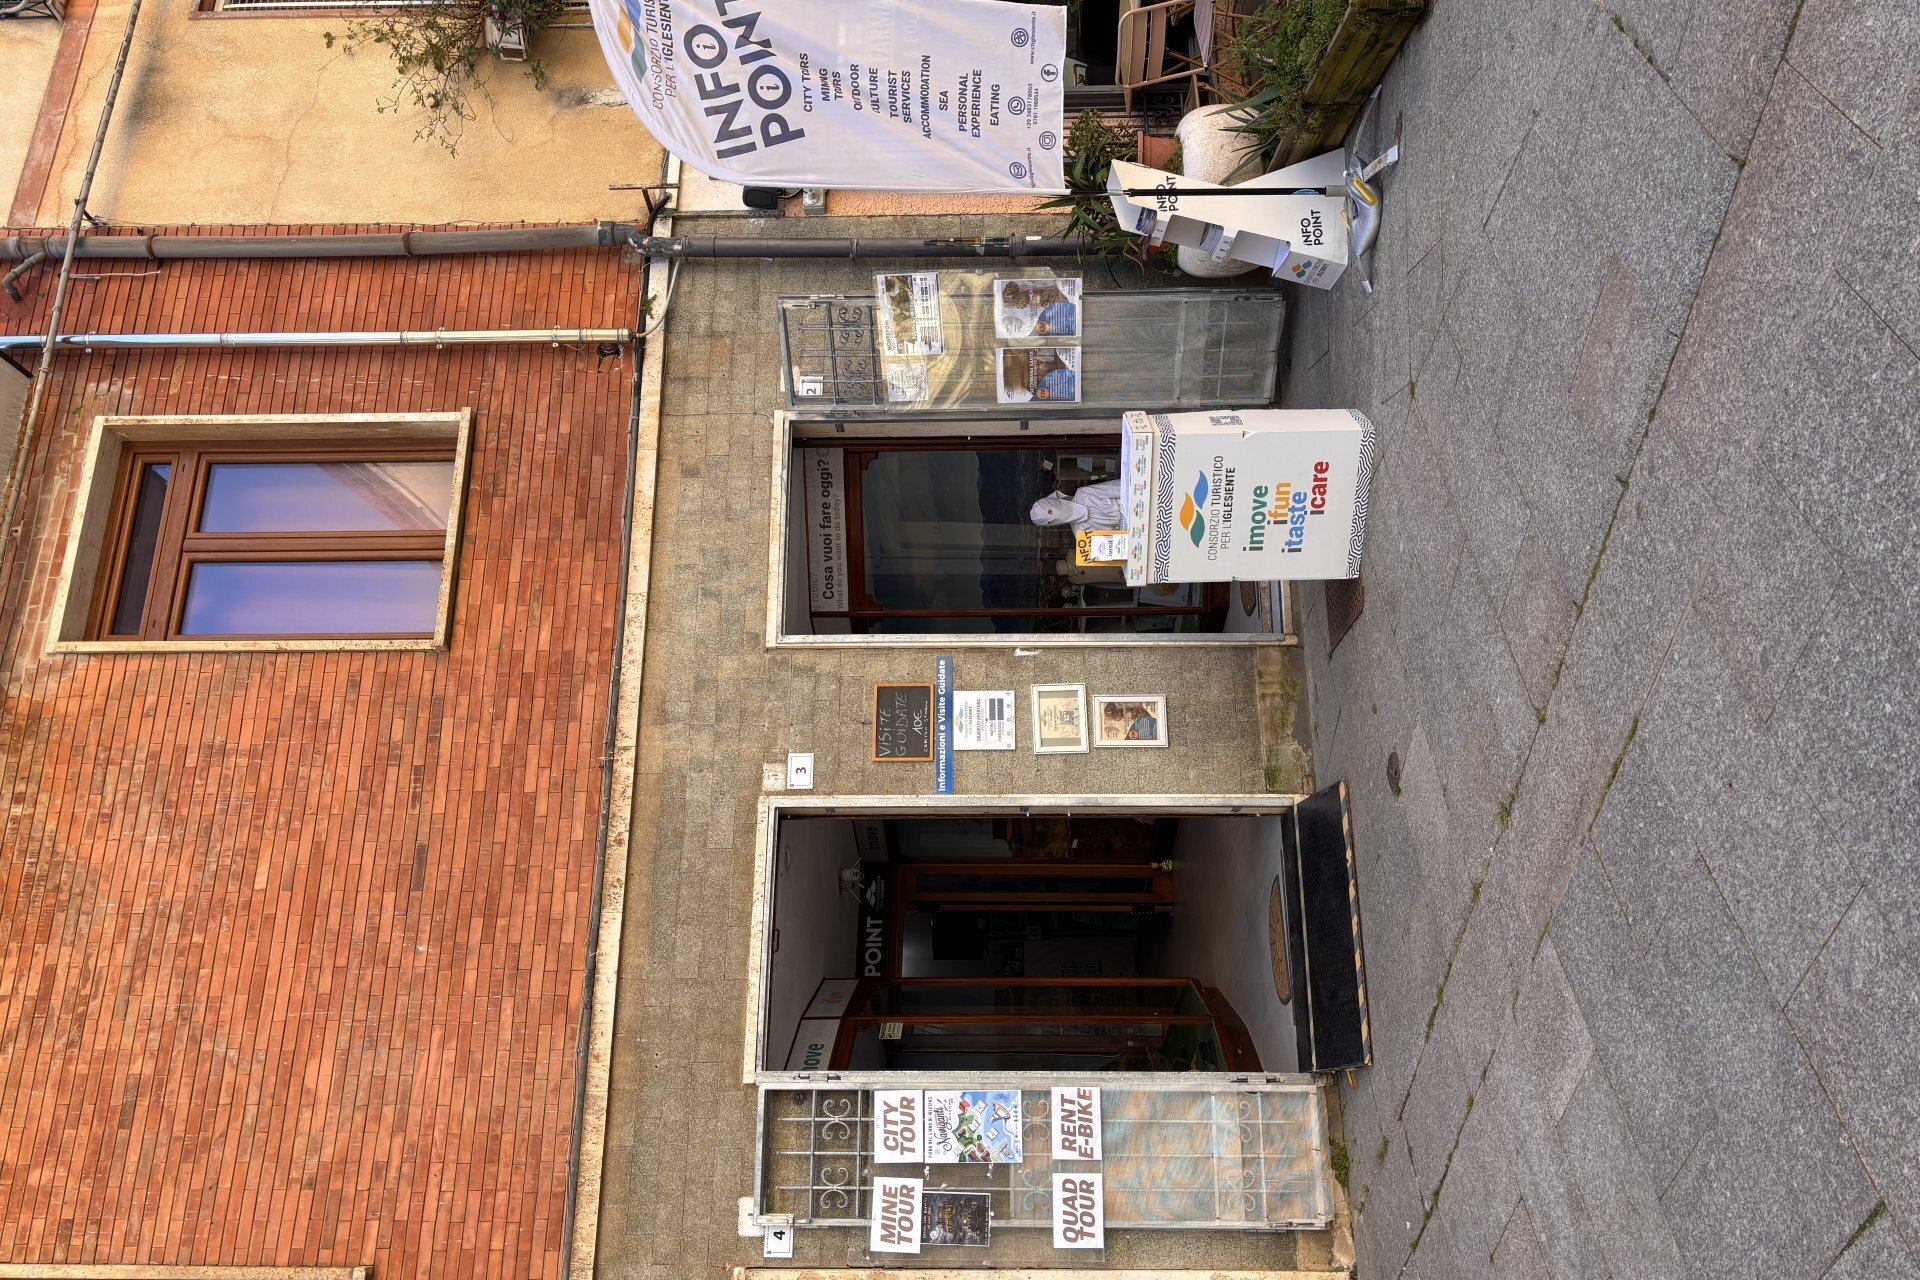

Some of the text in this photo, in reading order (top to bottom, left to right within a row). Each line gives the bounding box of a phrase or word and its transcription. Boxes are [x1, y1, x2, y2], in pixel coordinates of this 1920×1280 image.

[649, 38, 664, 109] CONSORZIO
[665, 74, 676, 98] PER
[684, 24, 758, 159] INFO
[888, 70, 899, 118] TOURIST
[901, 70, 912, 123] SERVICES
[920, 55, 932, 139] ACCOMMODATION
[803, 86, 812, 112] CITY
[939, 90, 948, 111] SEA
[958, 73, 968, 132] PERSONAL
[971, 69, 982, 138] EXPERIENCE
[990, 84, 1000, 126] EATING
[1166, 176, 1178, 211] PONT
[1301, 218, 1313, 246] INFO
[1311, 210, 1324, 245] POINT
[817, 459, 833, 497] oggi?
[1304, 462, 1329, 515] icare
[820, 502, 831, 529] fare
[833, 494, 842, 520] today?
[834, 522, 840, 530] do
[1208, 455, 1223, 560] CONSORZIO TURISTICO
[1221, 468, 1235, 549] PER L'IGLESIENTE
[1243, 486, 1268, 551] imove
[1267, 482, 1291, 525] ifun
[1282, 492, 1307, 553] itaste
[820, 534, 833, 562] vuoi
[835, 532, 841, 540] to
[1078, 540, 1092, 563] INFO
[822, 566, 834, 599] Cosa
[836, 579, 843, 587] do
[938, 660, 946, 695] Guidate
[912, 709, 923, 735] 10€
[938, 697, 946, 723] Visite
[938, 733, 946, 791] Informazioni
[864, 916, 883, 977] POINT
[884, 1101, 899, 1151] CITY
[900, 1096, 915, 1155] TOUR
[1061, 1094, 1077, 1152] RENT
[1077, 1088, 1094, 1159] E-BIKE
[880, 1184, 898, 1244] MINE
[897, 1185, 915, 1245] TOUR
[1062, 1178, 1081, 1243] QUAD
[1079, 1180, 1095, 1240] TOUR
[773, 1230, 785, 1240] 4
